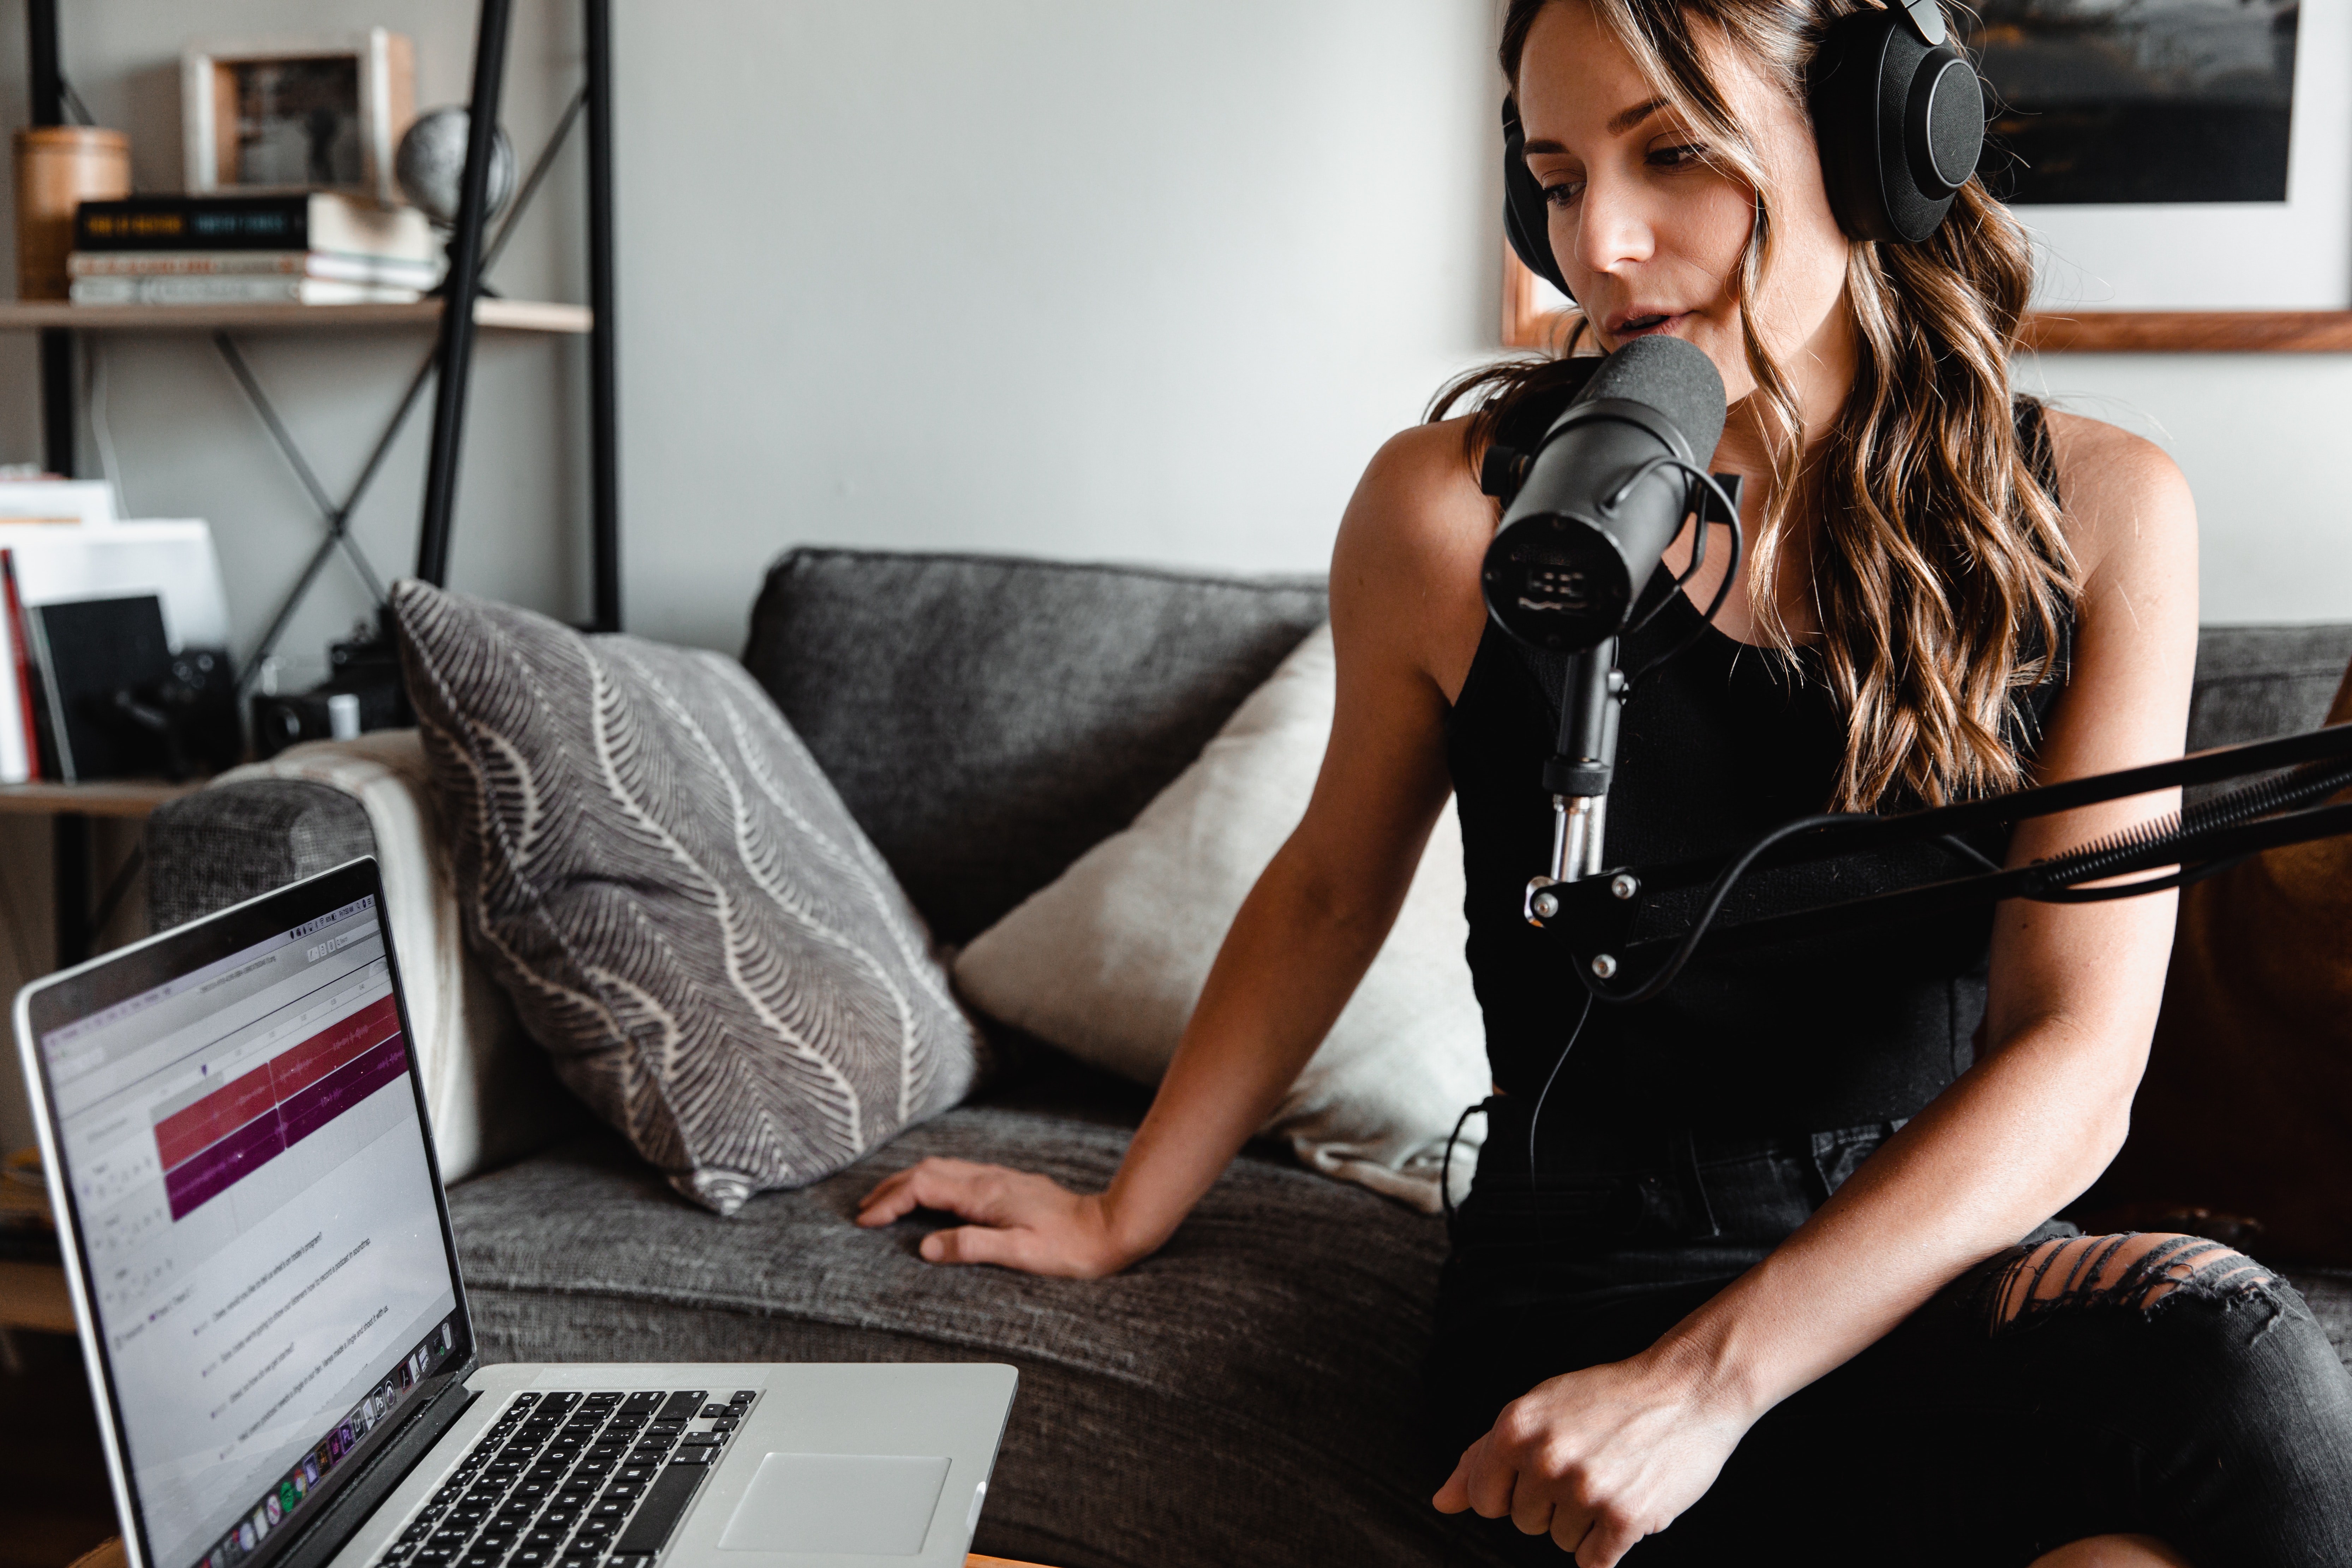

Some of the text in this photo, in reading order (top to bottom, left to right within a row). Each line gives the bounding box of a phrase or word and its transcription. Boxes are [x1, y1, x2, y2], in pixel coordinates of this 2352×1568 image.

[286, 1258, 291, 1266] on
[291, 1247, 305, 1262] today's
[305, 1232, 322, 1251] program?
[273, 1308, 283, 1321] show
[291, 1289, 307, 1306] listeners
[307, 1282, 315, 1293] how
[315, 1279, 320, 1287] to
[319, 1267, 332, 1283] record
[335, 1253, 349, 1271] podcast
[334, 1345, 343, 1358] made
[346, 1333, 357, 1346] jingle
[363, 1317, 373, 1331] shoot
[376, 1397, 384, 1411] Ps
[354, 1418, 361, 1432] Lr
[714, 1432, 723, 1441] option
[701, 1448, 713, 1461] command
